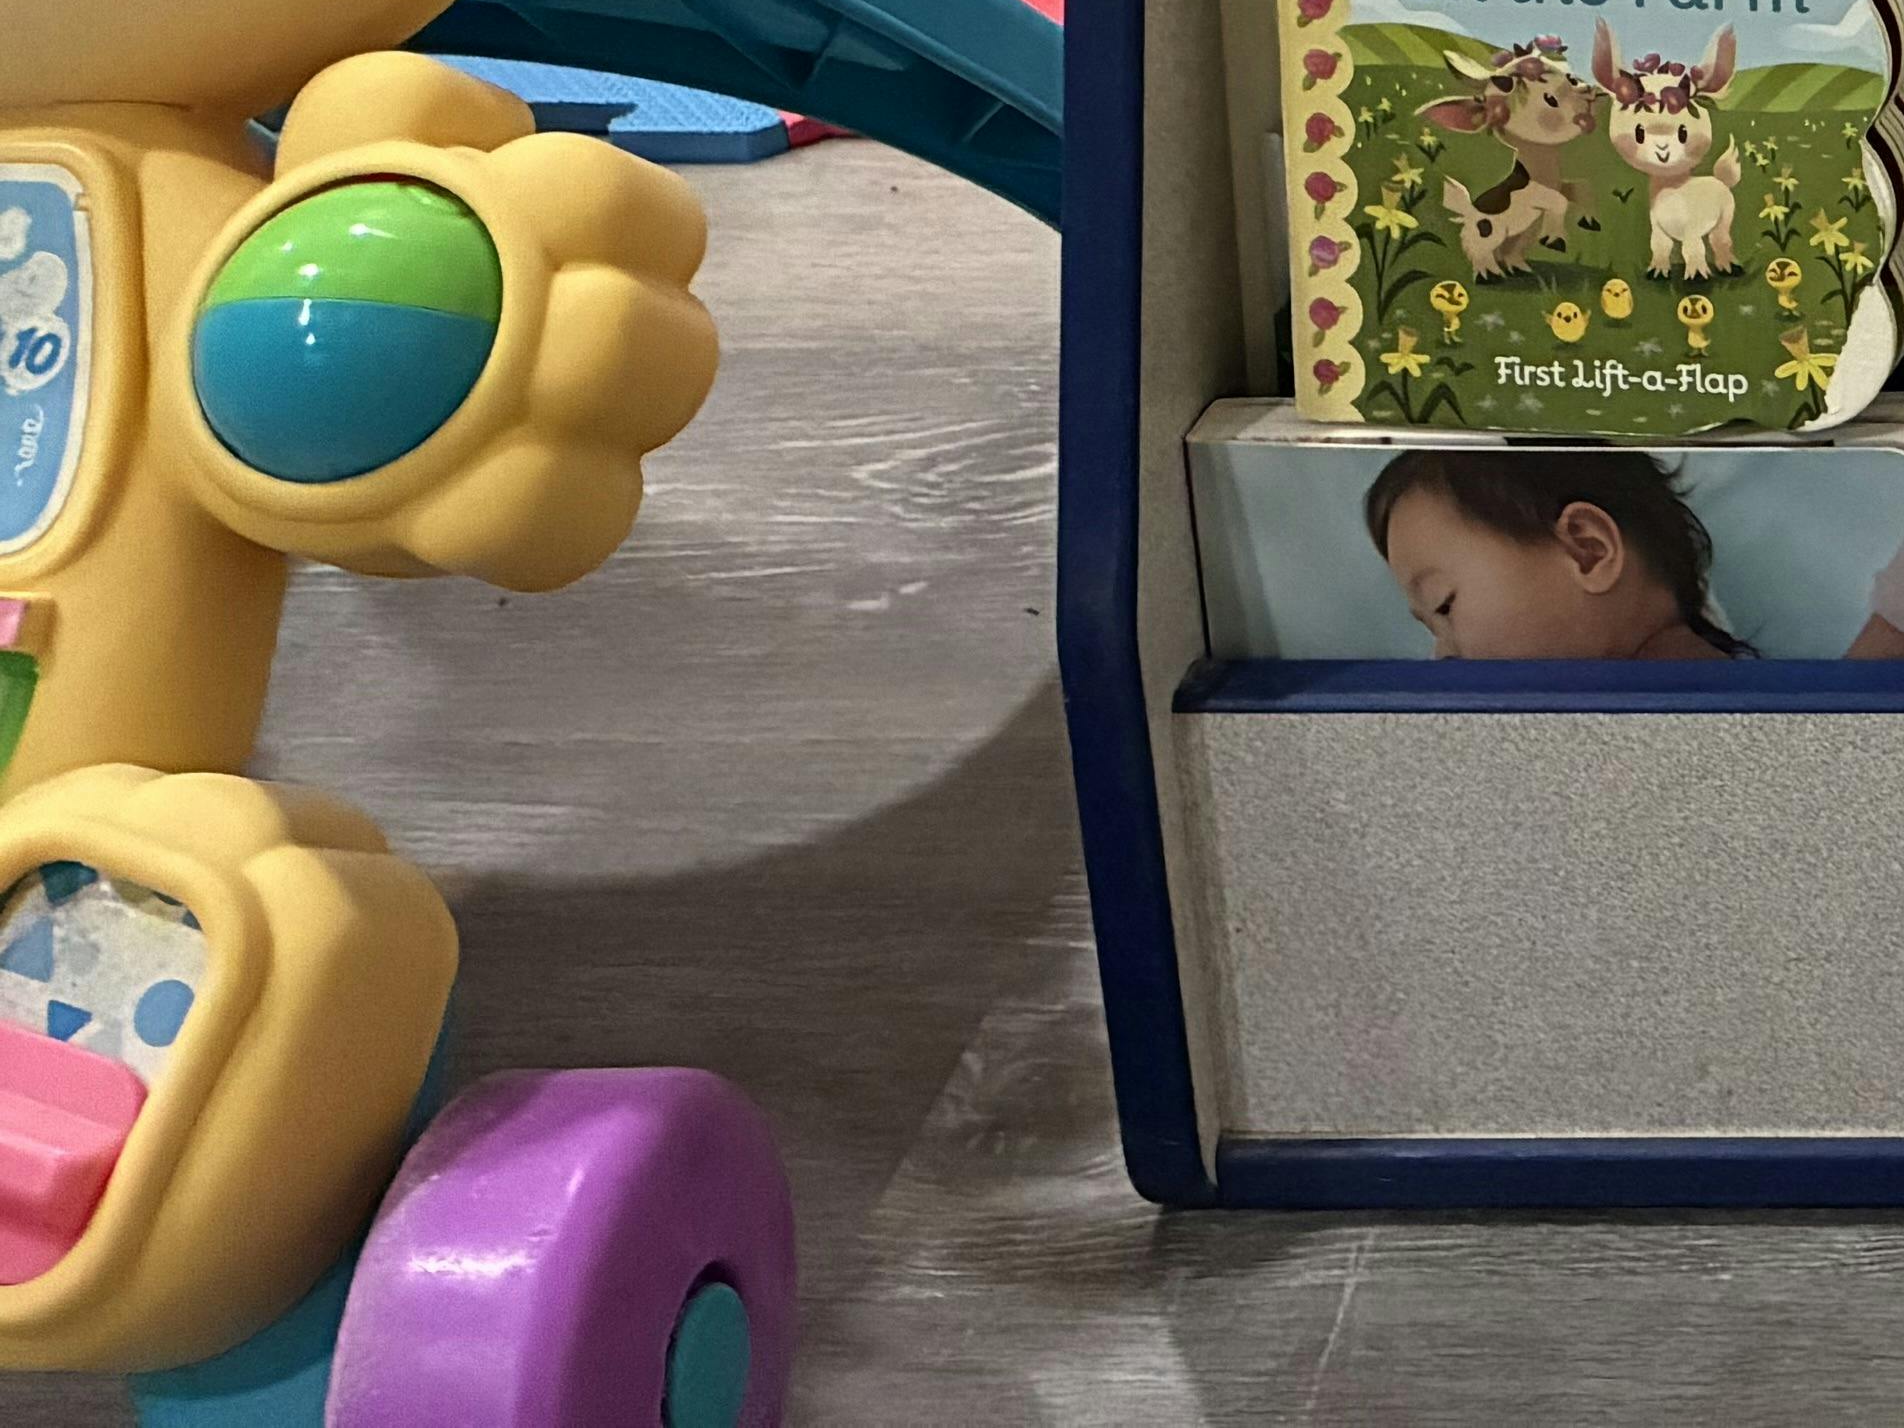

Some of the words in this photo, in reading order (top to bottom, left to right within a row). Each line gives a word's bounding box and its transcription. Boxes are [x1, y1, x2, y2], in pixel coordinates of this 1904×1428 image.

[8, 327, 63, 375] 10
[1494, 356, 1567, 389] First
[1573, 359, 1750, 403] Lift-a-Flap
